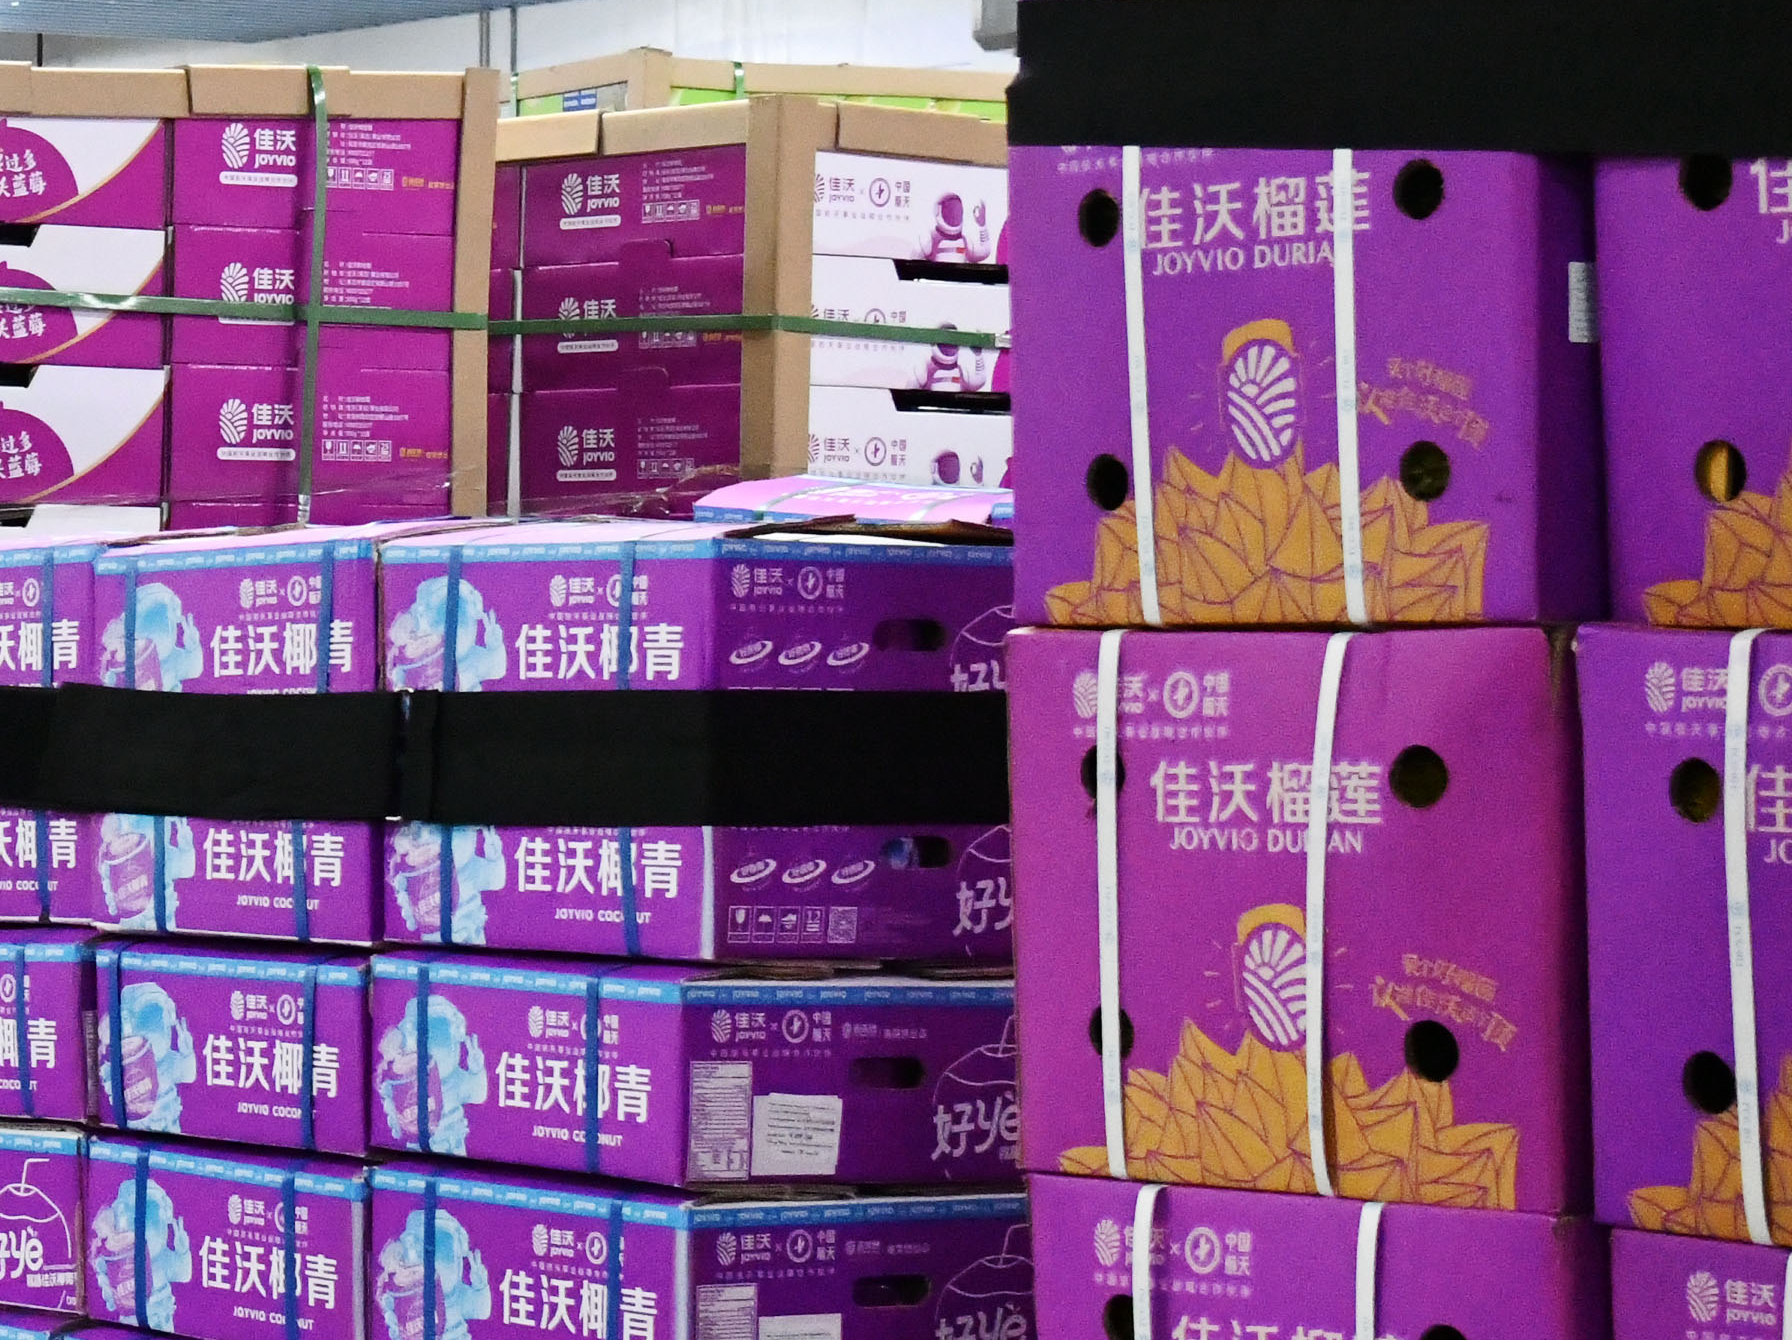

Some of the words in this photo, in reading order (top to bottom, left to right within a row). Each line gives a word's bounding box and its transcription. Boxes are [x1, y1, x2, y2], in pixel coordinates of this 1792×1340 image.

[254, 129, 296, 151] 佳沃
[254, 154, 296, 168] JOYVIO
[586, 174, 620, 195] 佳沃
[830, 178, 854, 191] 佳沃
[586, 194, 619, 212] JOYVIO
[1139, 170, 1371, 250] 佳沃榴莲
[1149, 246, 1244, 275] JOYVIO
[253, 268, 294, 289] 佳沃
[251, 292, 296, 305] JOYVIO
[252, 292, 296, 305] 佳沃
[582, 429, 614, 448] 佳沃
[824, 438, 849, 456] 佳沃
[582, 446, 614, 464] JOYVIO
[754, 568, 782, 583] 佳沃
[564, 578, 594, 596] 佳沃
[210, 616, 353, 677] 佳沃椰青
[515, 623, 684, 680] 佳沃椰青
[1149, 759, 1382, 824] 佳沃榴莲
[1169, 826, 1258, 851] JOYVIO
[203, 824, 344, 886] 佳沃椰青
[514, 835, 682, 898] 佳沃椰青
[236, 895, 270, 907] JOYVIO
[554, 908, 594, 921] JOYVIO
[542, 1010, 573, 1029] 佳沃
[735, 1013, 765, 1028] 佳沃
[203, 1032, 339, 1097] 佳沃椰青
[496, 1048, 651, 1123] 佳沃椰青
[237, 1103, 269, 1115] JOYVIO
[532, 1126, 569, 1140] JOYVIO
[546, 1229, 574, 1247] 佳沃
[741, 1234, 771, 1254] 佳沃
[199, 1232, 338, 1312] 佳沃椰青
[1725, 1280, 1775, 1311] 佳沃
[232, 1307, 266, 1321] JOYVIO
